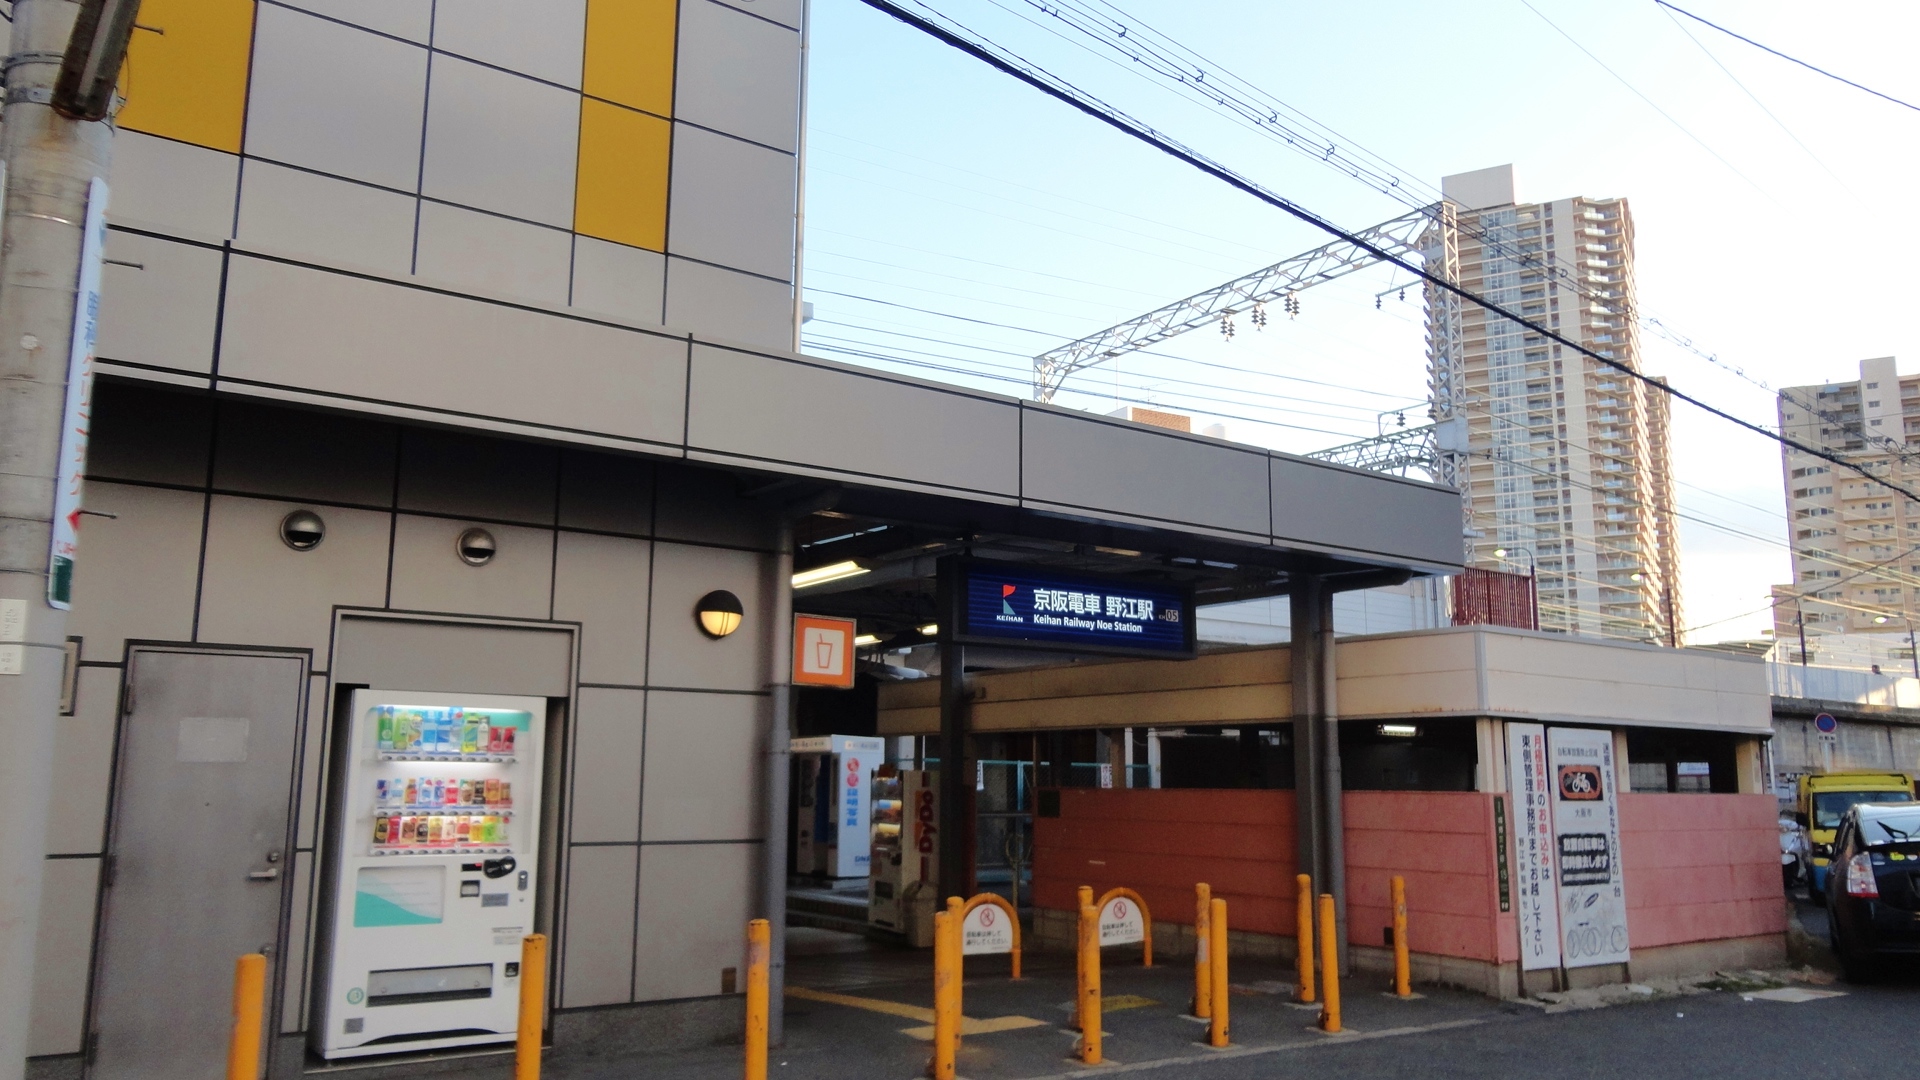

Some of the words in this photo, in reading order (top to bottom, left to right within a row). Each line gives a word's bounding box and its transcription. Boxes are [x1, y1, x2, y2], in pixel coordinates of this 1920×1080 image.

[996, 614, 1024, 623] KEIHAN
[1033, 588, 1101, 615] 京阪電車
[1106, 596, 1154, 621] 野江駅
[1166, 610, 1178, 621] 05
[1033, 613, 1062, 626] Keihan
[1063, 617, 1095, 631] Railway
[1096, 620, 1113, 630] Noe
[1114, 622, 1143, 633] Station
[919, 789, 937, 853] DyDo
[1534, 734, 1550, 881] 月極契約のお申込みは
[1521, 734, 1544, 957] 東側管理事務所までお越し下さい
